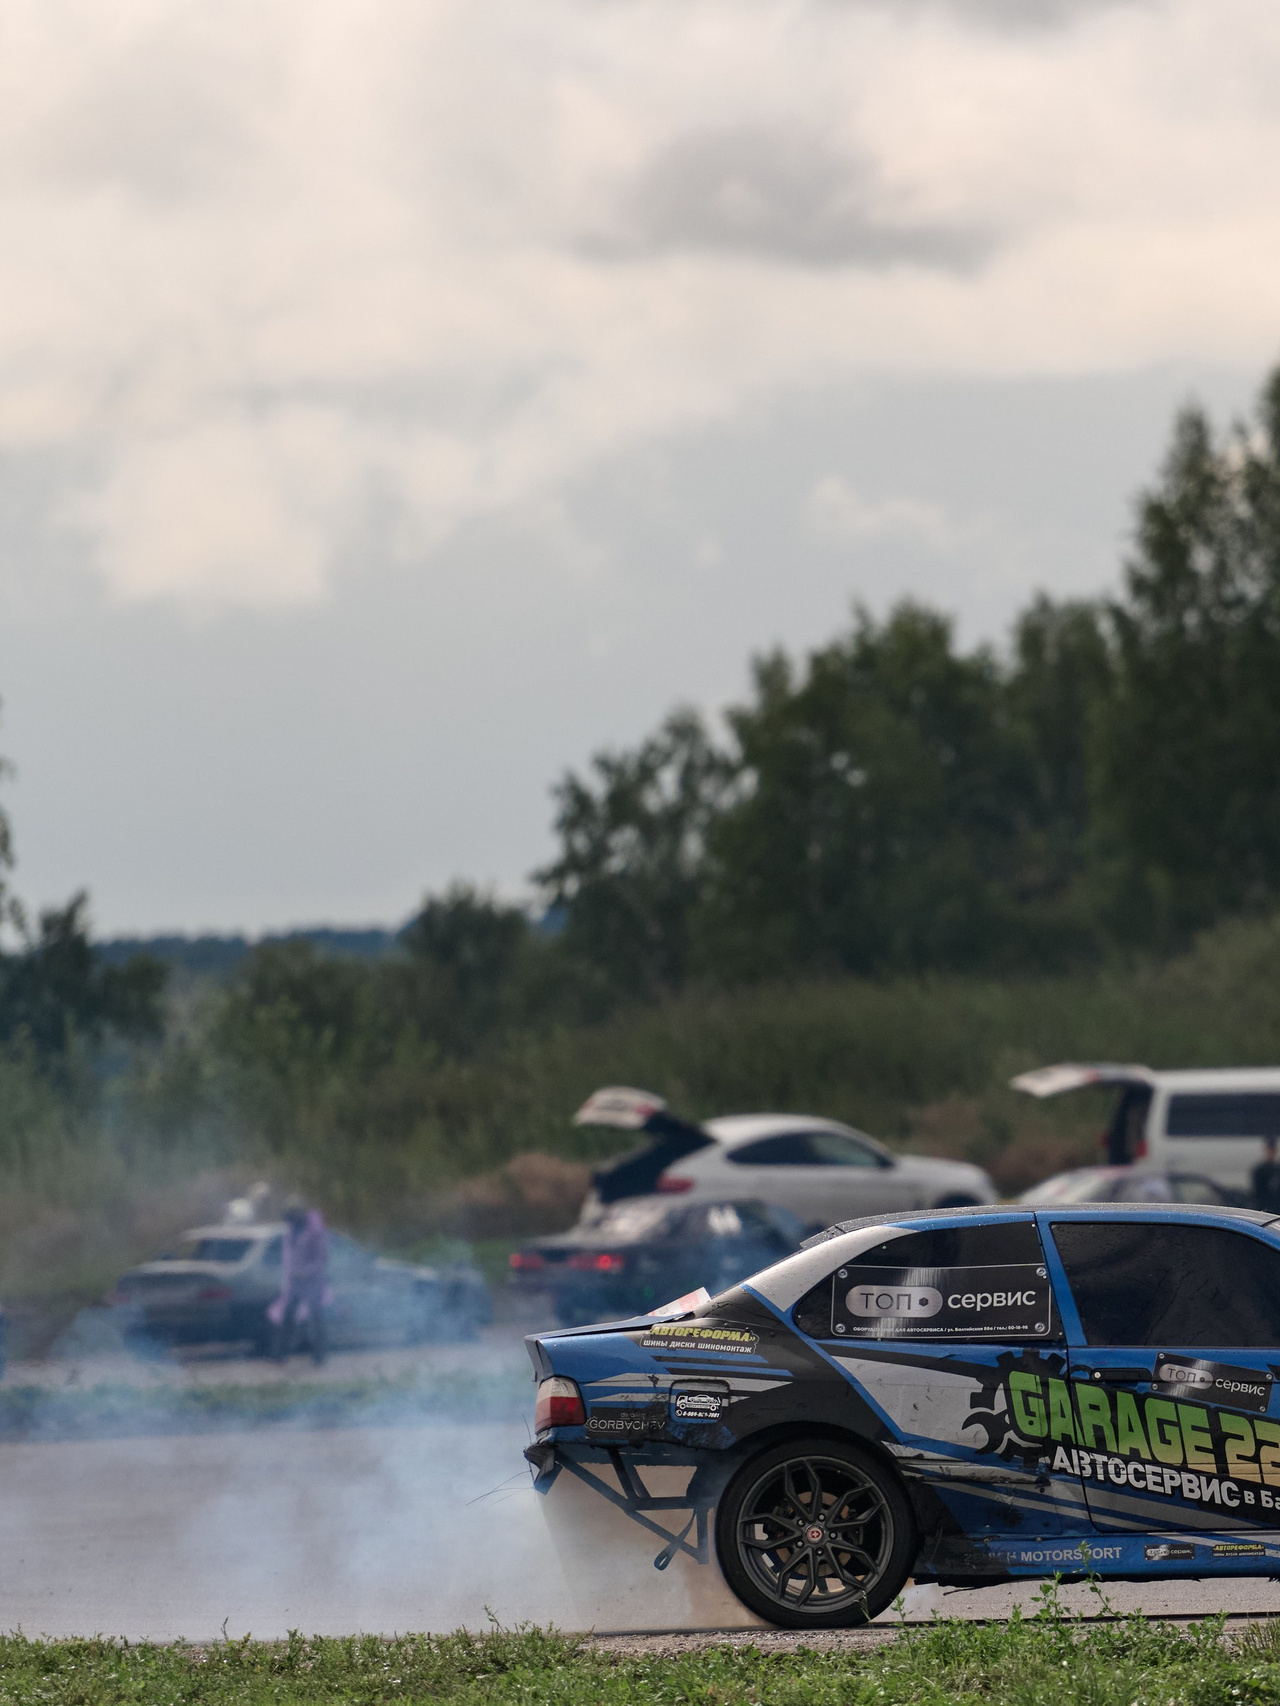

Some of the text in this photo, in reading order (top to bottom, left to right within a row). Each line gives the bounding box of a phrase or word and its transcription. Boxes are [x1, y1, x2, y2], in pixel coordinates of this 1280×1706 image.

[860, 1291, 1037, 1311] ТОП сервис
[669, 1341, 696, 1349] диски
[697, 1343, 753, 1353] шиномонтаж
[1168, 1368, 1265, 1396] ТОП сервис
[1009, 1371, 1217, 1474] GARAGE
[1052, 1446, 1240, 1507] АВТОСЕРВИС
[1244, 1490, 1255, 1504] в
